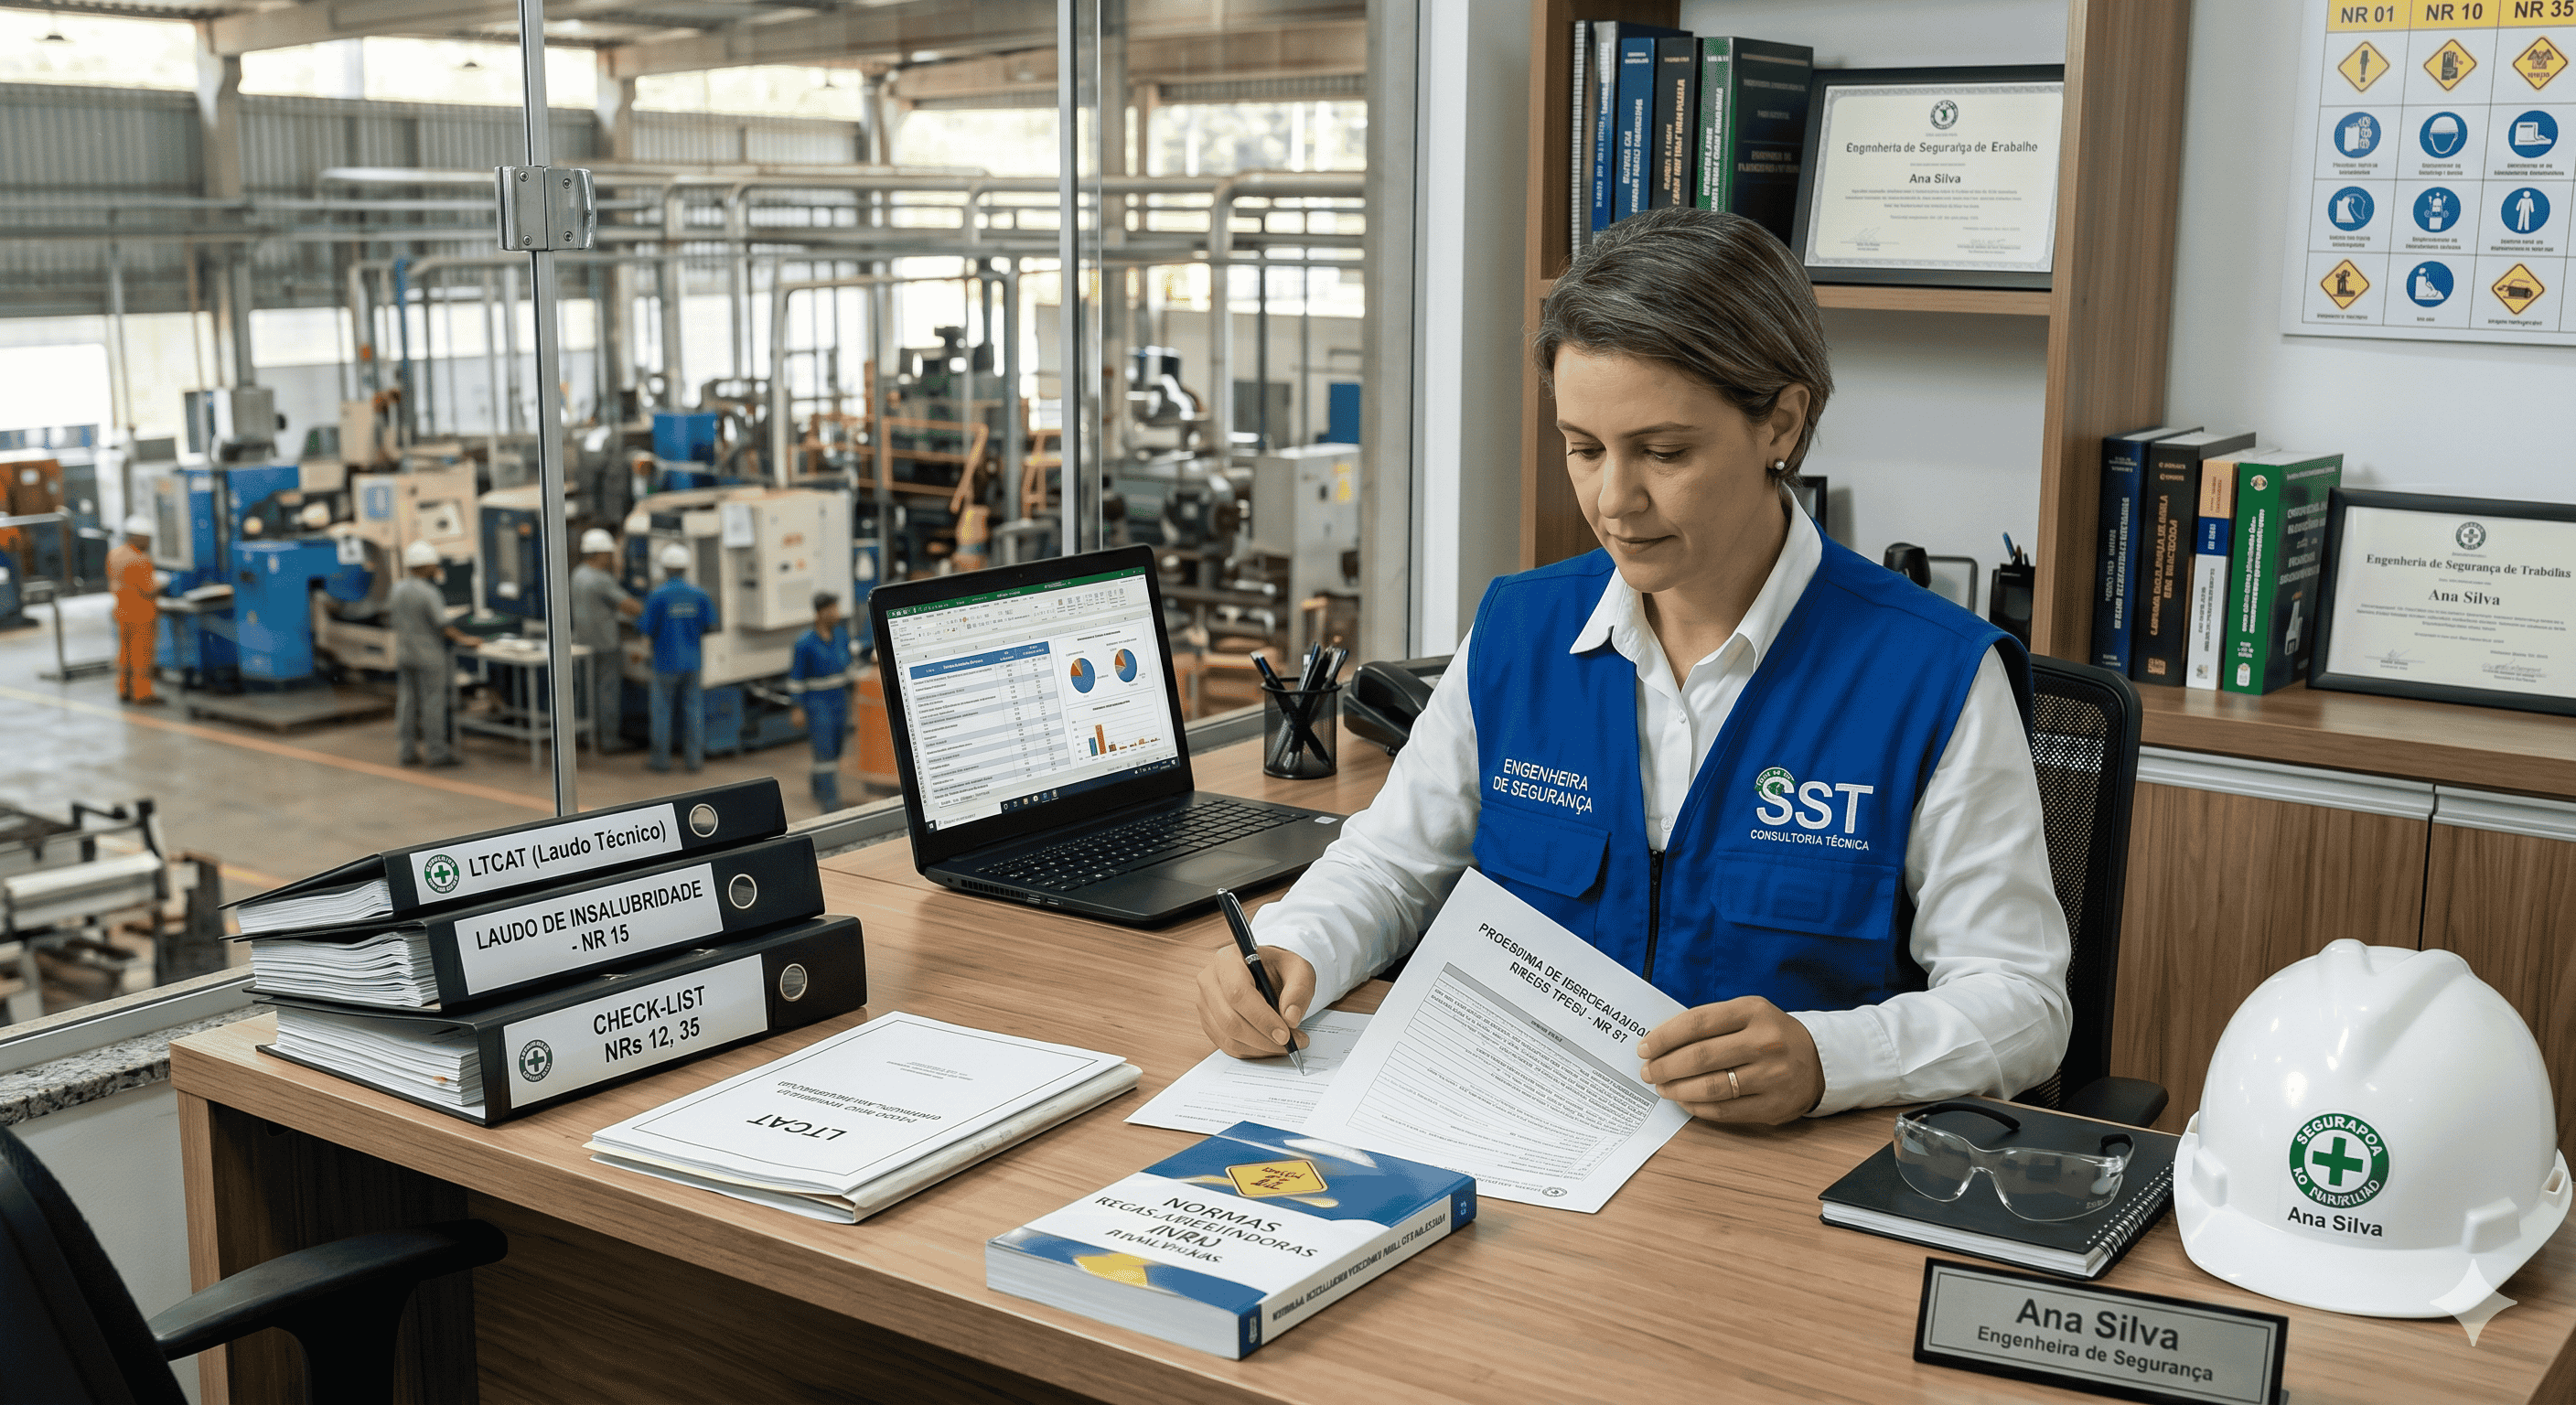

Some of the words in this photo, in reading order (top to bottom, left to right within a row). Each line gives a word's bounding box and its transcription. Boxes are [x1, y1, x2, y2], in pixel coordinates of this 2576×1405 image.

[2341, 6, 2368, 24] NR
[2374, 5, 2395, 22] 01
[2426, 4, 2453, 21] NR
[2461, 3, 2483, 20] 10
[2514, 1, 2544, 18] NR
[2550, 0, 2575, 17] 35
[1904, 142, 1916, 153] de
[1974, 142, 1987, 152] de
[1909, 174, 1931, 184] Ana
[1934, 173, 1961, 184] Silva
[2429, 558, 2443, 569] de
[2504, 563, 2517, 574] de
[2428, 589, 2459, 603] Ana
[2463, 591, 2501, 606] Silva
[1503, 758, 1589, 791] ENGENHEIRA
[1492, 776, 1509, 793] DE
[1512, 778, 1594, 815] SEGURANÇA
[1755, 775, 1874, 834] SST
[468, 848, 528, 878] LTCAT
[532, 836, 591, 872] (Laudo
[595, 820, 668, 858] Técnico)
[1750, 829, 1823, 845] CONSULTORIA
[1825, 834, 1870, 852] TÉCNICA
[476, 917, 538, 950] LAUDO
[542, 911, 568, 936] DE
[570, 879, 704, 928] INSALUBRIDADE
[582, 928, 606, 953] NR
[610, 923, 630, 947] 15
[1544, 965, 1563, 983] DE
[593, 985, 706, 1036] CHECK-LIST
[605, 1031, 643, 1064] NRs
[648, 1023, 675, 1055] 12,
[679, 1016, 702, 1042] 35
[1593, 1017, 1613, 1035] NR
[746, 1112, 848, 1142] LTCAT
[1163, 1197, 1283, 1233] NORMAS
[2287, 1206, 2326, 1229] Ana
[2332, 1215, 2384, 1238] Silva
[2015, 1297, 2084, 1335] Ana
[2094, 1310, 2180, 1352] Silva
[1977, 1325, 2079, 1358] Engenheira
[2085, 1345, 2108, 1363] de
[2113, 1349, 2215, 1383] Segurança
